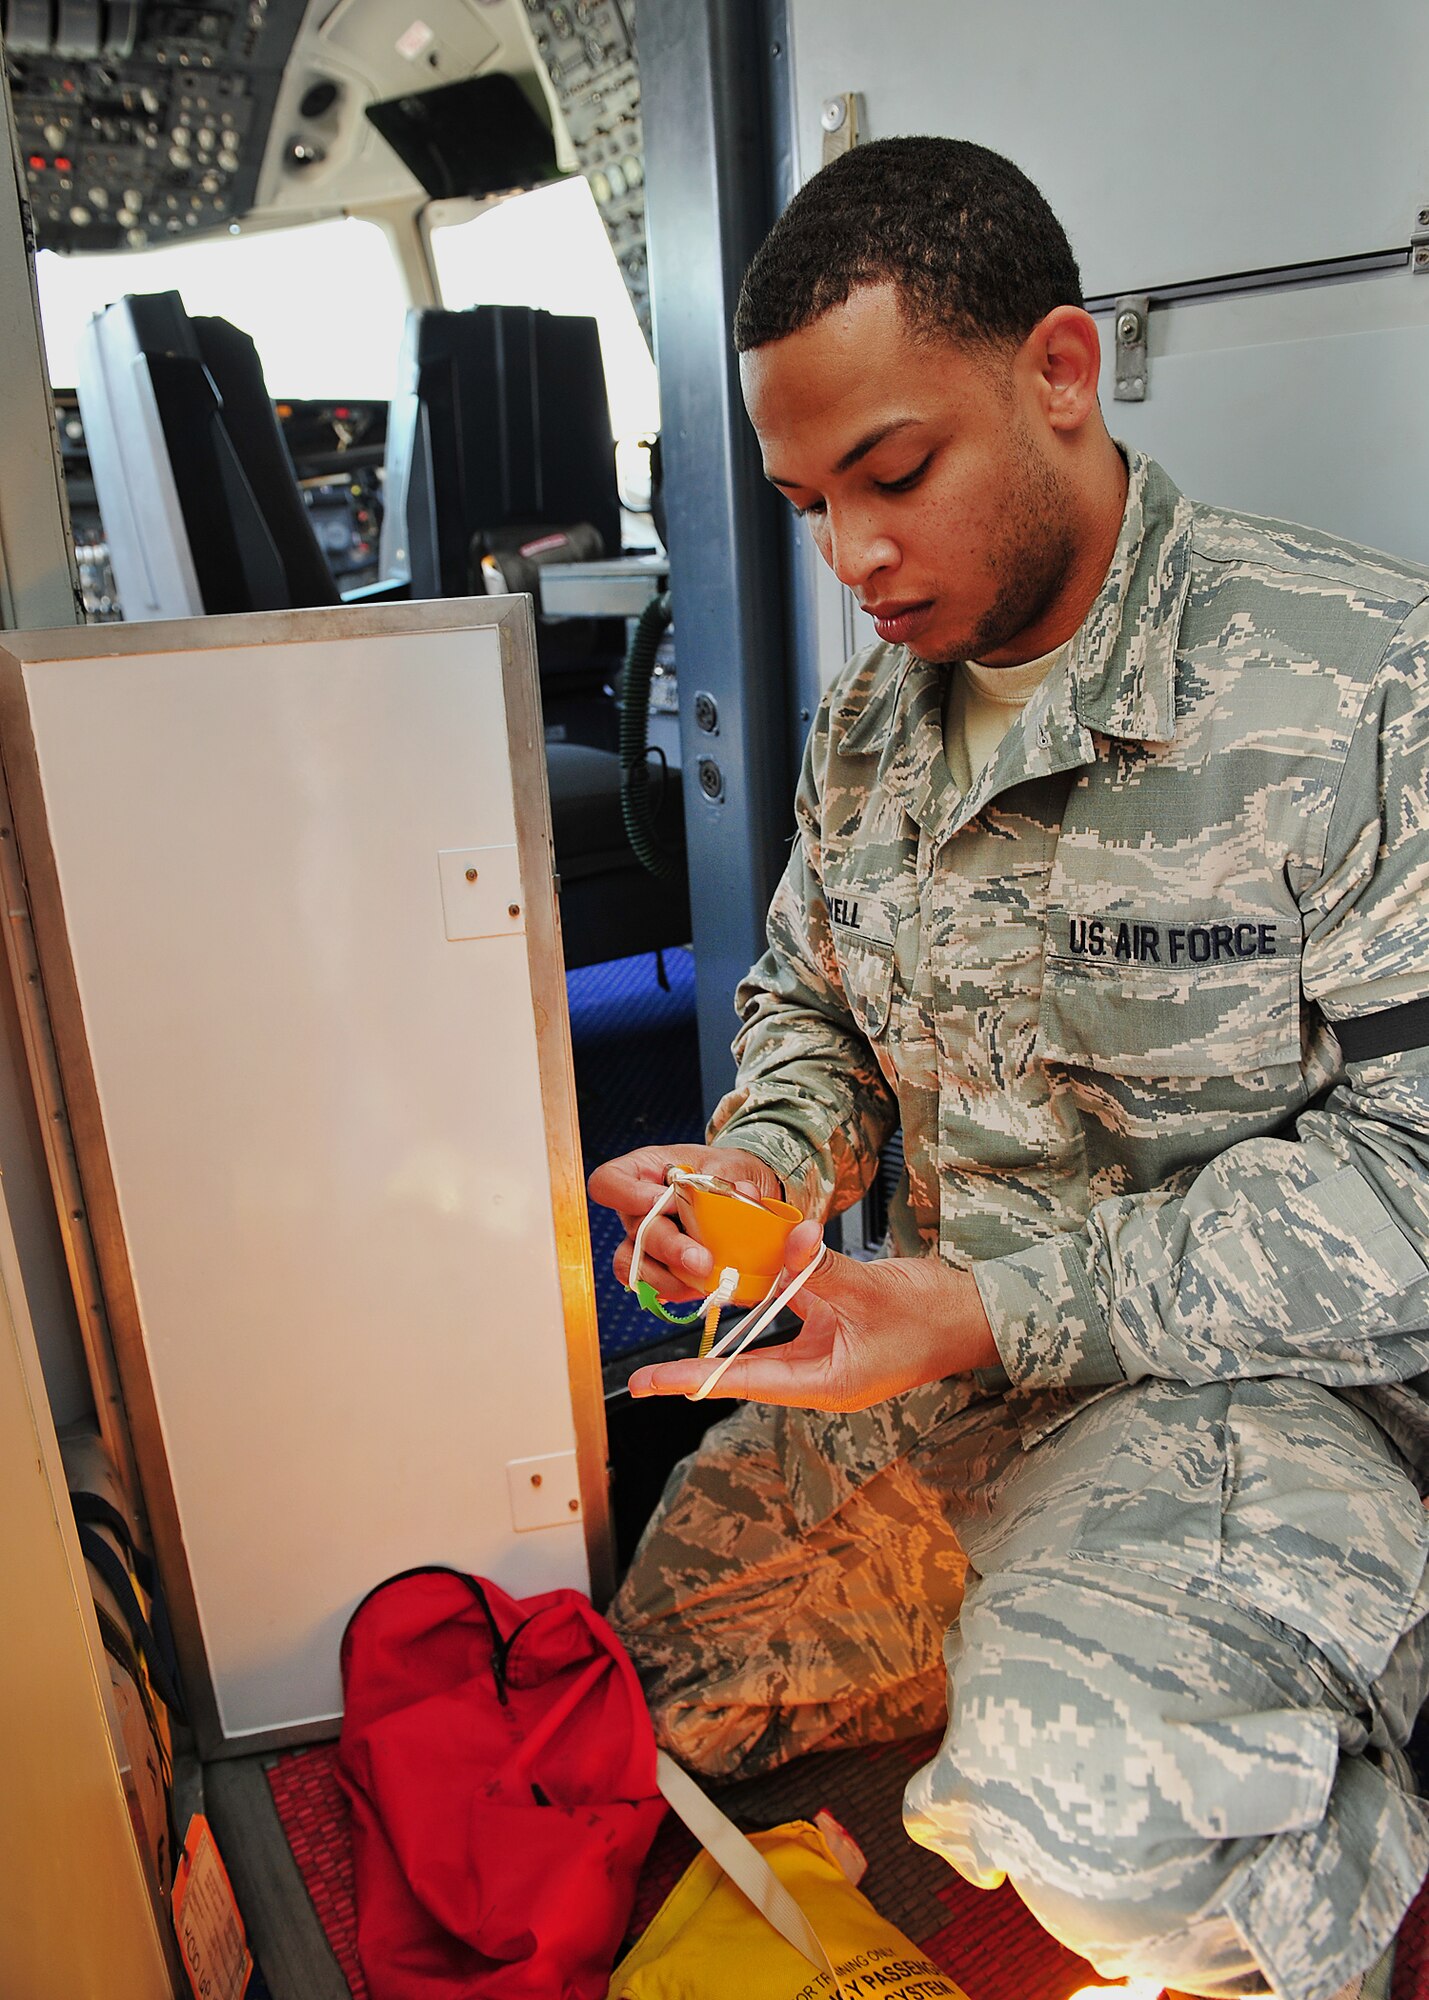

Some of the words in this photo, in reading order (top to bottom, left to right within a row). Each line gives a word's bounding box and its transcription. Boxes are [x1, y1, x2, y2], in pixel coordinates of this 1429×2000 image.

[1114, 922, 1161, 962] AIR
[1168, 923, 1277, 964] FORCE
[812, 1954, 869, 1989] TRINING
